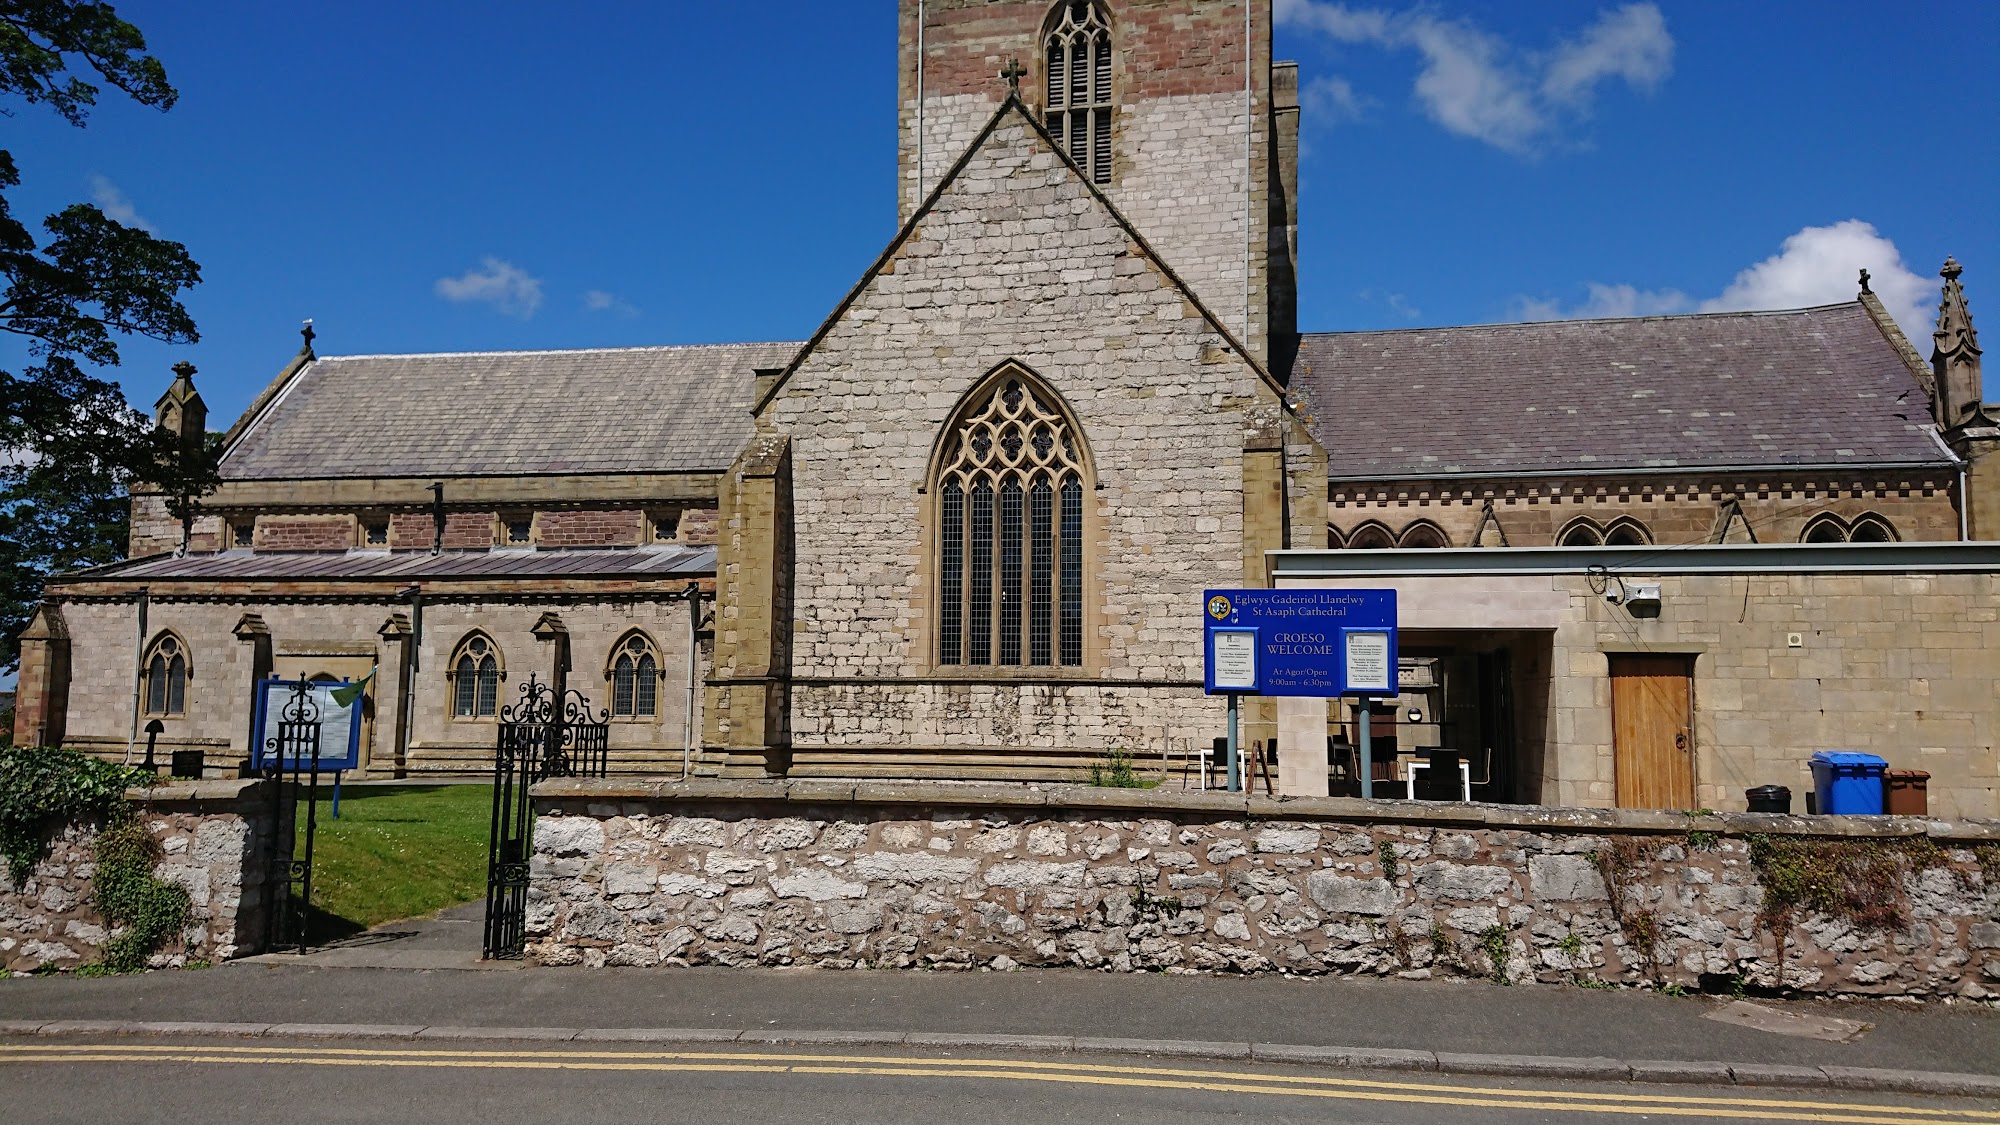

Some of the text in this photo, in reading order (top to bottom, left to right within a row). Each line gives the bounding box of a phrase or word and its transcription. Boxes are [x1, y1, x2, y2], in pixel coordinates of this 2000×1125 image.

[1235, 594, 1365, 606] Eglwys Gadeiriol Llanelwy
[1252, 607, 1346, 618] St Asaph Cathedral
[1274, 633, 1325, 643] CROESO
[1267, 645, 1333, 655] WELCOME
[1273, 668, 1328, 677] Ar Agor/Open
[1269, 678, 1297, 686] 9:00am
[1303, 678, 1332, 687] 6:30pm
